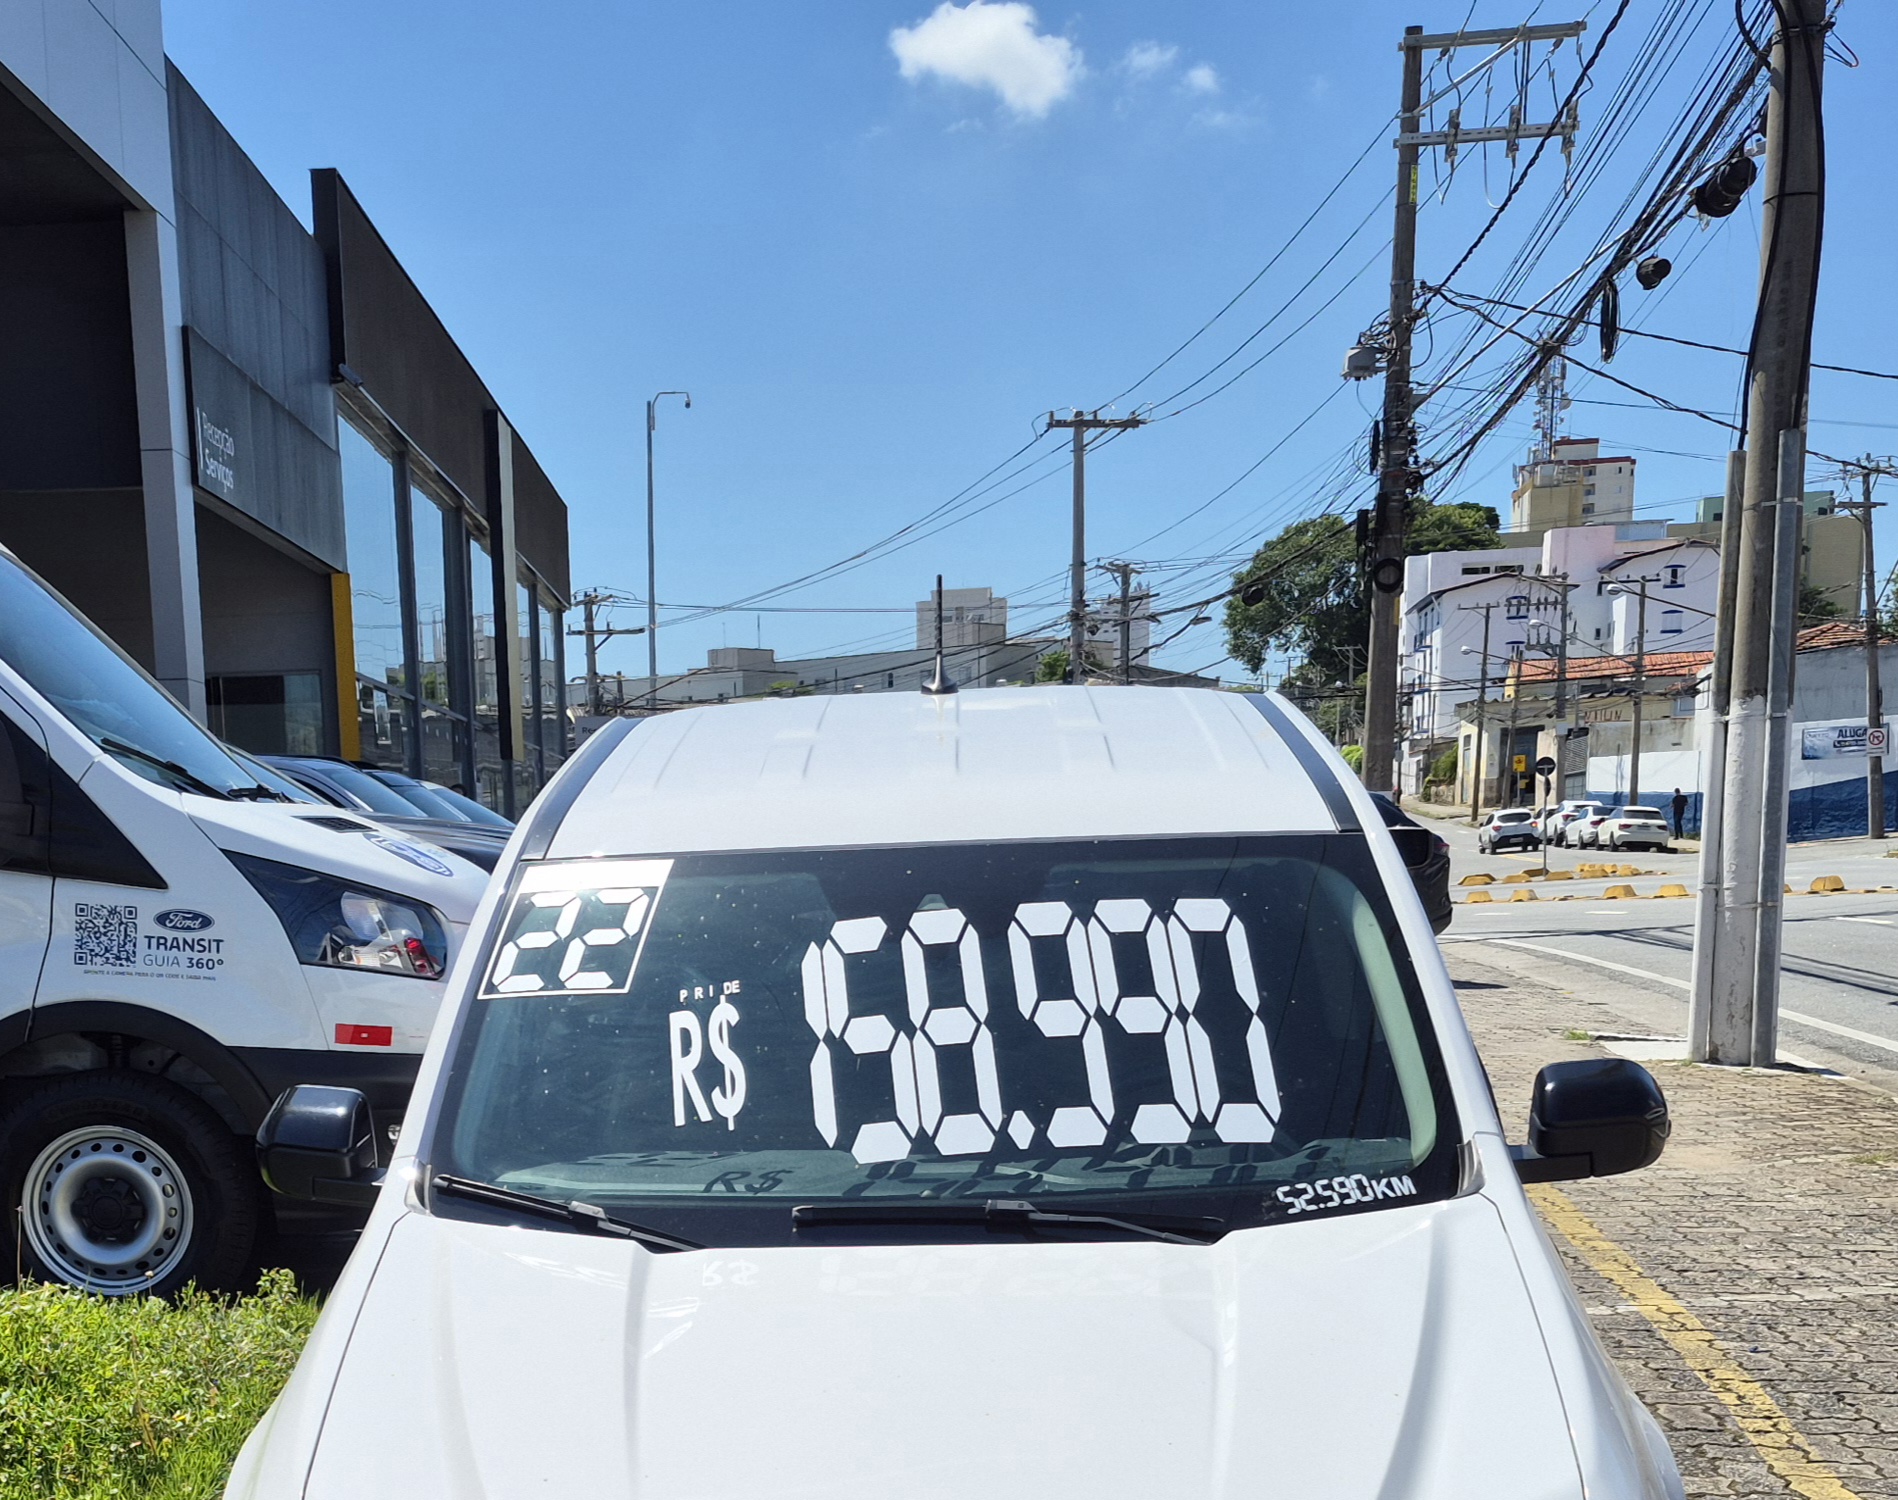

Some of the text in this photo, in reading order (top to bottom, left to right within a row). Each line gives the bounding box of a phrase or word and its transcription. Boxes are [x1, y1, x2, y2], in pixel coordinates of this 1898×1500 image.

[204, 447, 235, 493] Serviços
[164, 911, 203, 930] Ford
[491, 887, 650, 993] 22
[143, 935, 225, 955] TRANSIT
[143, 953, 181, 968] GUIA
[800, 898, 1283, 1165] 158.990
[668, 994, 747, 1132] R$
